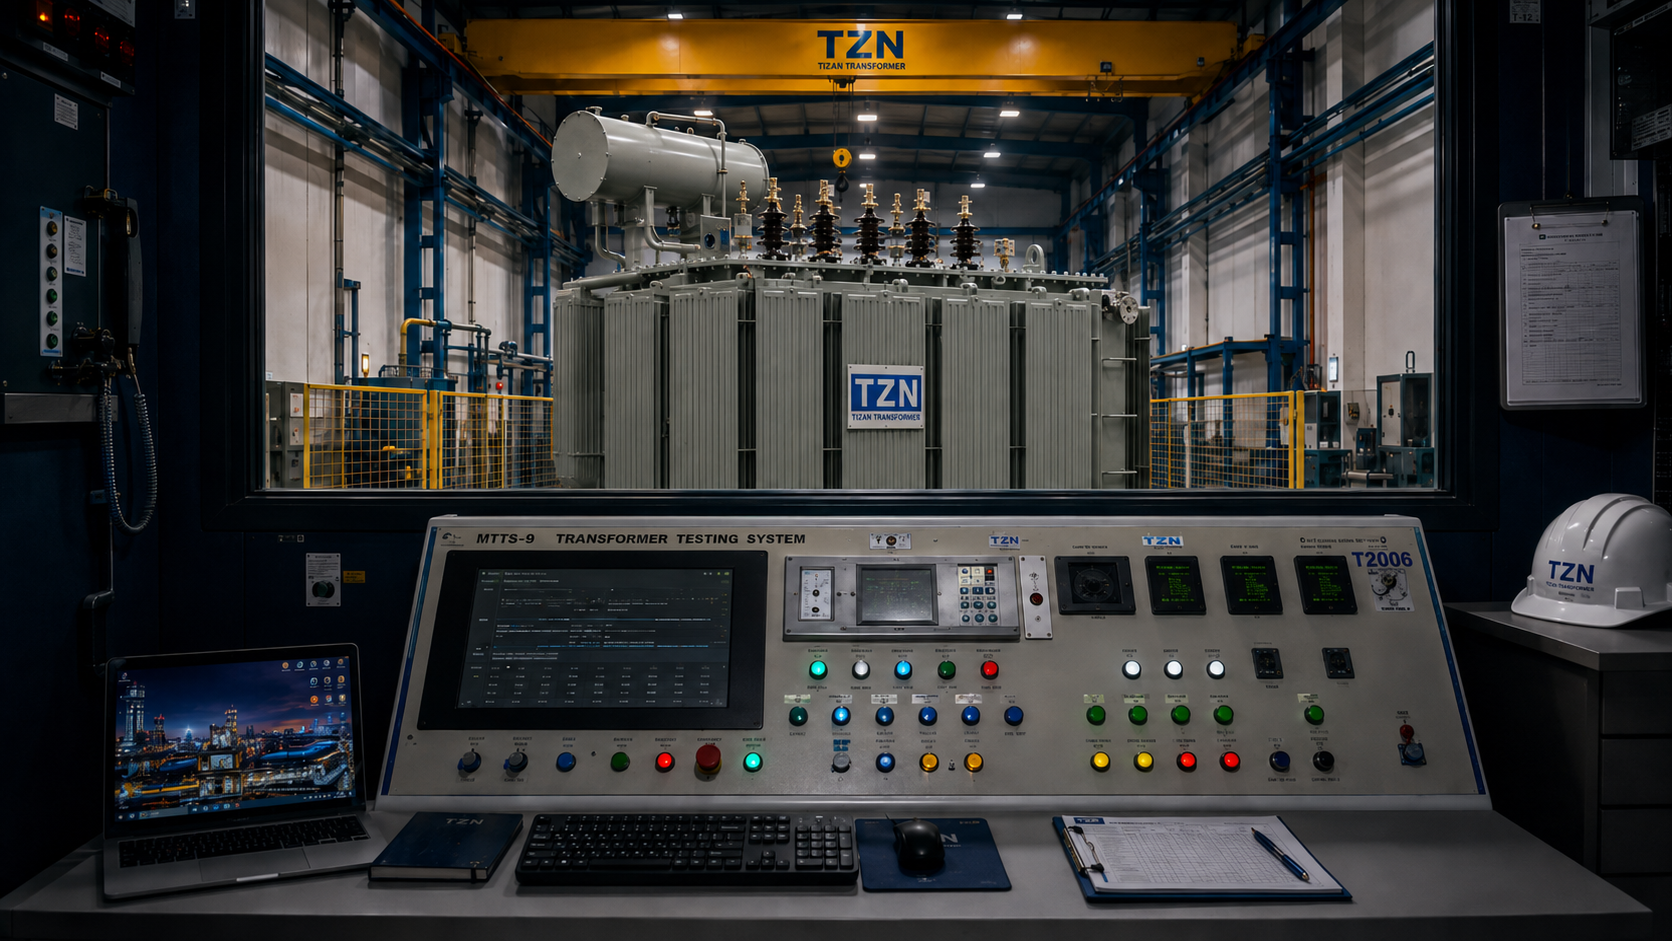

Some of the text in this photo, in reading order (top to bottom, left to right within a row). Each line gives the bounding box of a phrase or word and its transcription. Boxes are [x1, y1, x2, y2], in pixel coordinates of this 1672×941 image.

[817, 30, 904, 58] TZN
[818, 62, 906, 70] TIZAN TRANSFORMER
[854, 378, 918, 407] TZN
[851, 413, 872, 421] TIZAN
[476, 533, 536, 545] MTTS-9
[556, 533, 669, 544] TRANSFORMER
[676, 533, 739, 544] TESTING
[746, 533, 806, 544] SYSTEM
[1142, 536, 1182, 545] TZN
[1351, 551, 1413, 567] T2006
[1548, 560, 1595, 584] TZN
